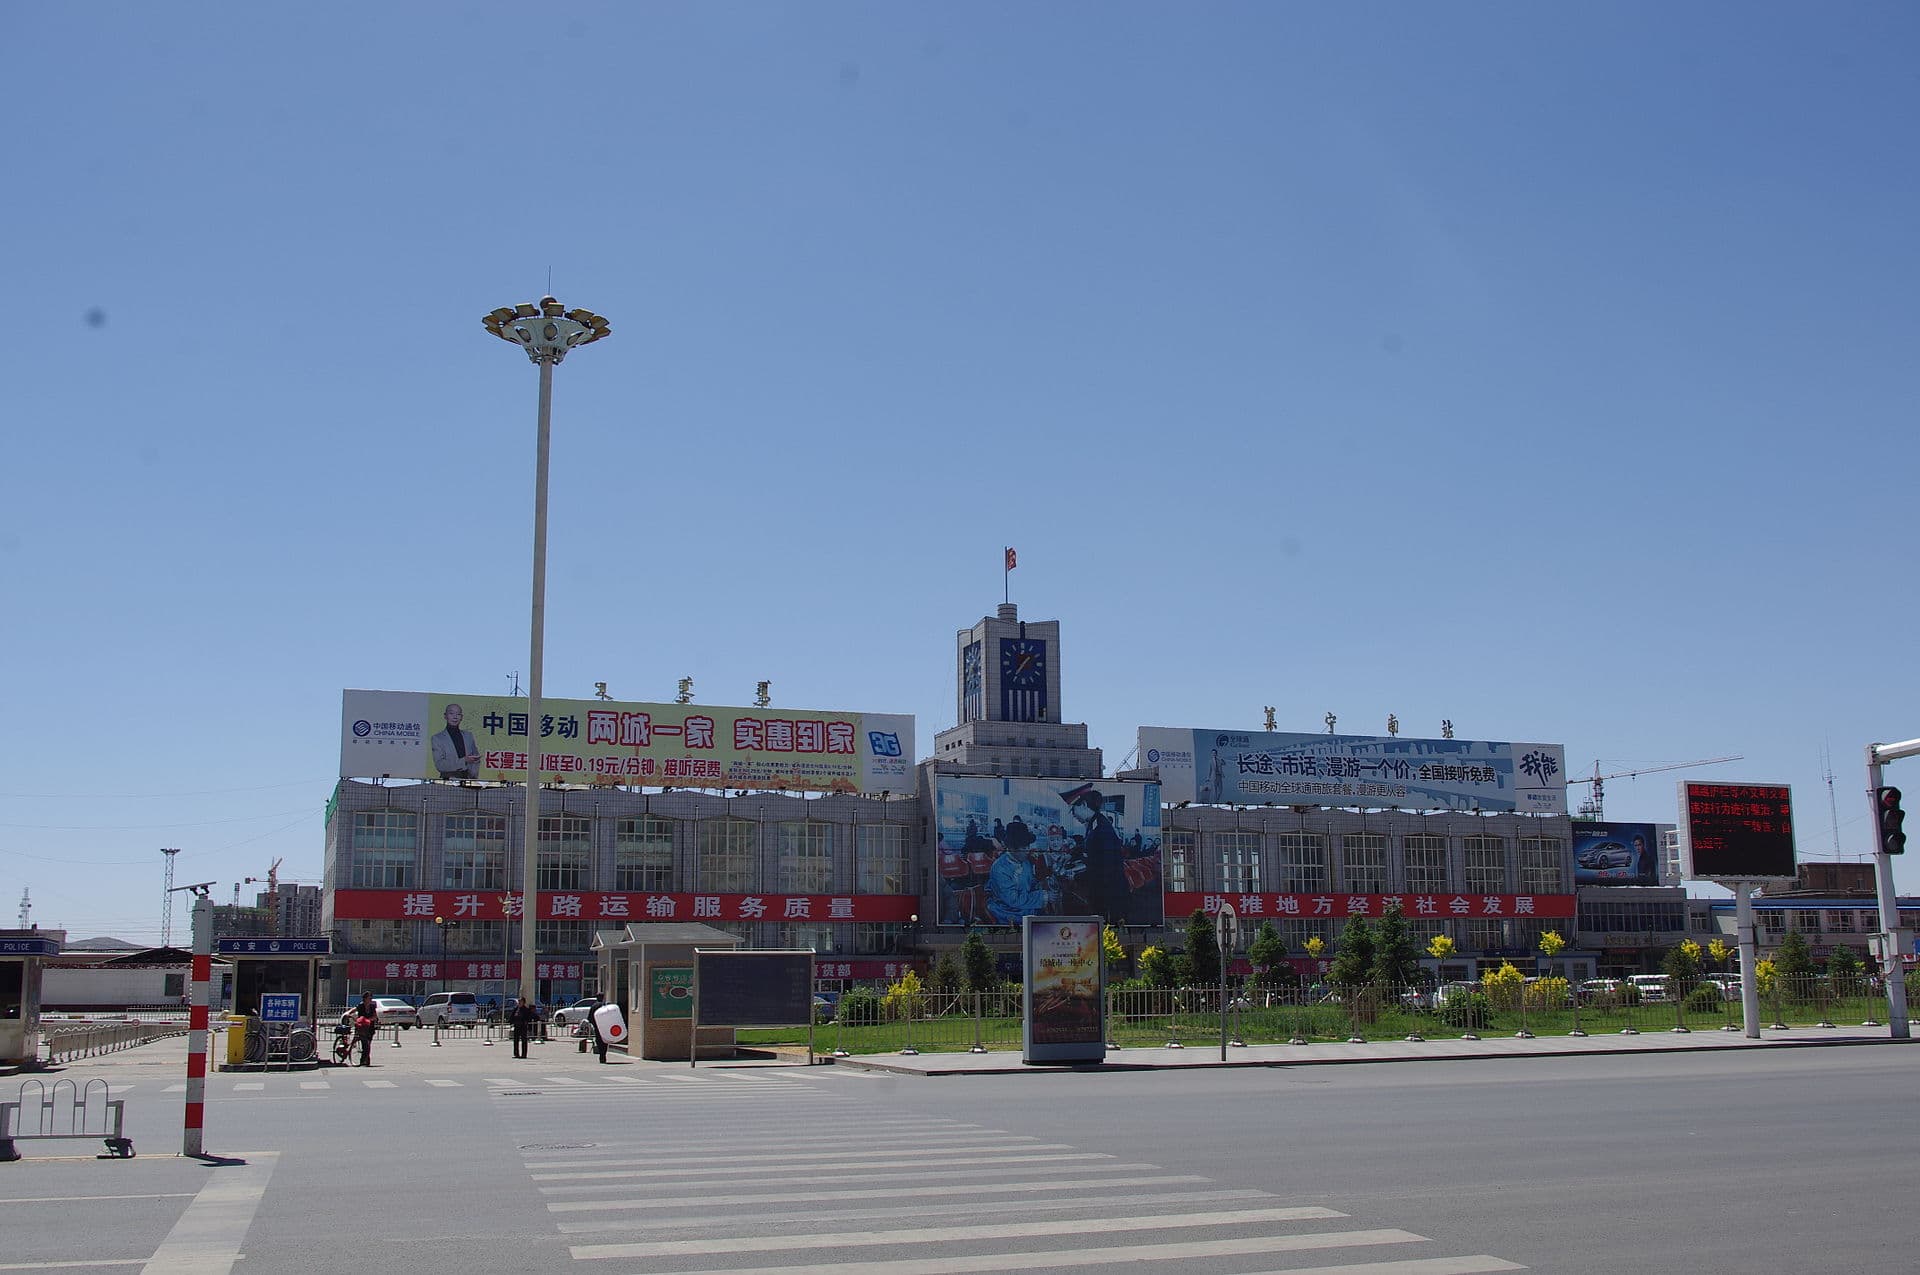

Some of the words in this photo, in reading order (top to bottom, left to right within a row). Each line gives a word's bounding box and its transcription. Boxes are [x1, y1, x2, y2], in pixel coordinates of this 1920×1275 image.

[373, 722, 421, 731] 中国移动通信
[483, 711, 579, 739] 中国移动
[587, 710, 715, 750] 两城一家
[734, 717, 856, 754] 实惠到家
[873, 733, 901, 755] 3G
[485, 750, 655, 776] 长漫主低至0.19元/分钟
[664, 757, 721, 778] 接听免费
[1519, 750, 1559, 786] 我能
[3, 943, 30, 951] POLICE
[232, 942, 256, 950] 公安
[293, 942, 317, 950] POLICE
[385, 963, 437, 978] 售货部
[467, 963, 506, 978] 售货部
[537, 963, 581, 978] 售货部
[815, 963, 851, 977] 货部
[267, 999, 295, 1008] 各种车辆
[266, 1009, 294, 1018] 禁止通行
